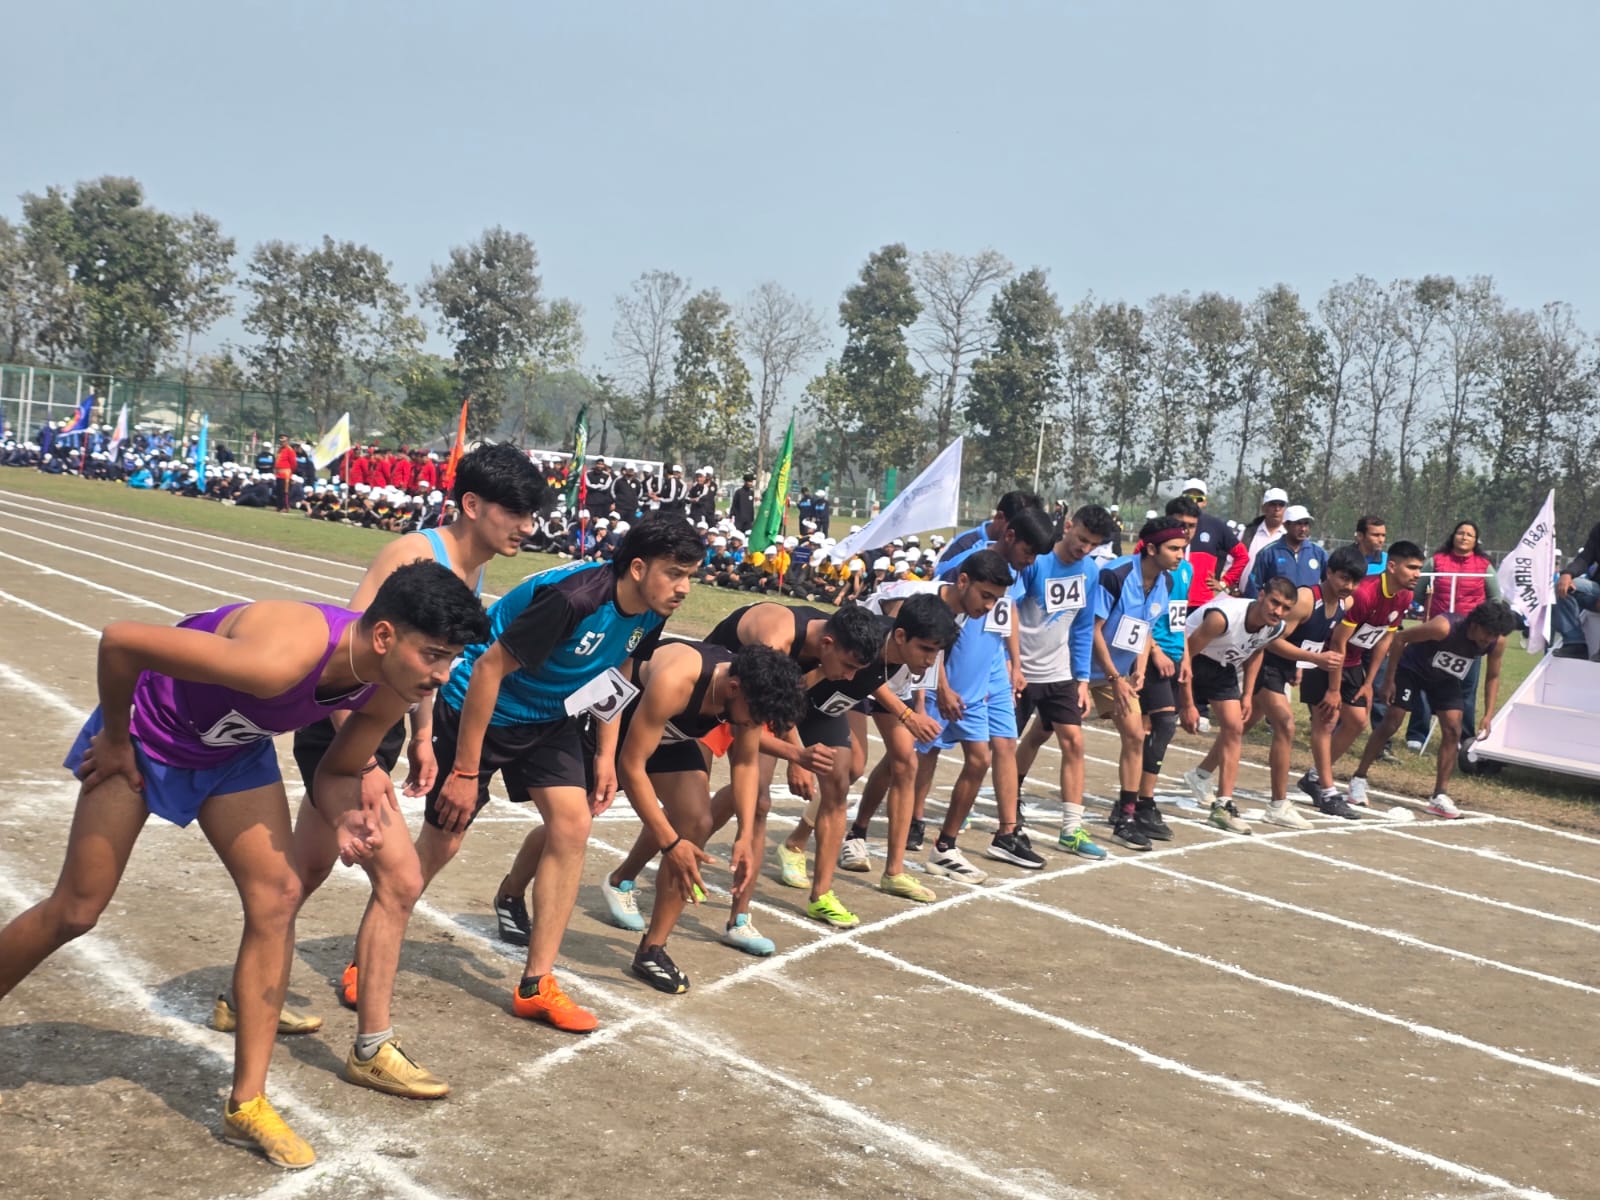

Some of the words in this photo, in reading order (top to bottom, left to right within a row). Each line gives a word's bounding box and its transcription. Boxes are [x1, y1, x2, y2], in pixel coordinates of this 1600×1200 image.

[1050, 580, 1080, 605] 94
[994, 600, 1009, 625] 6
[1169, 606, 1186, 626] 25
[574, 630, 606, 656] 57
[1127, 624, 1141, 645] 5
[1437, 653, 1467, 673] 38
[1401, 688, 1412, 701] 3
